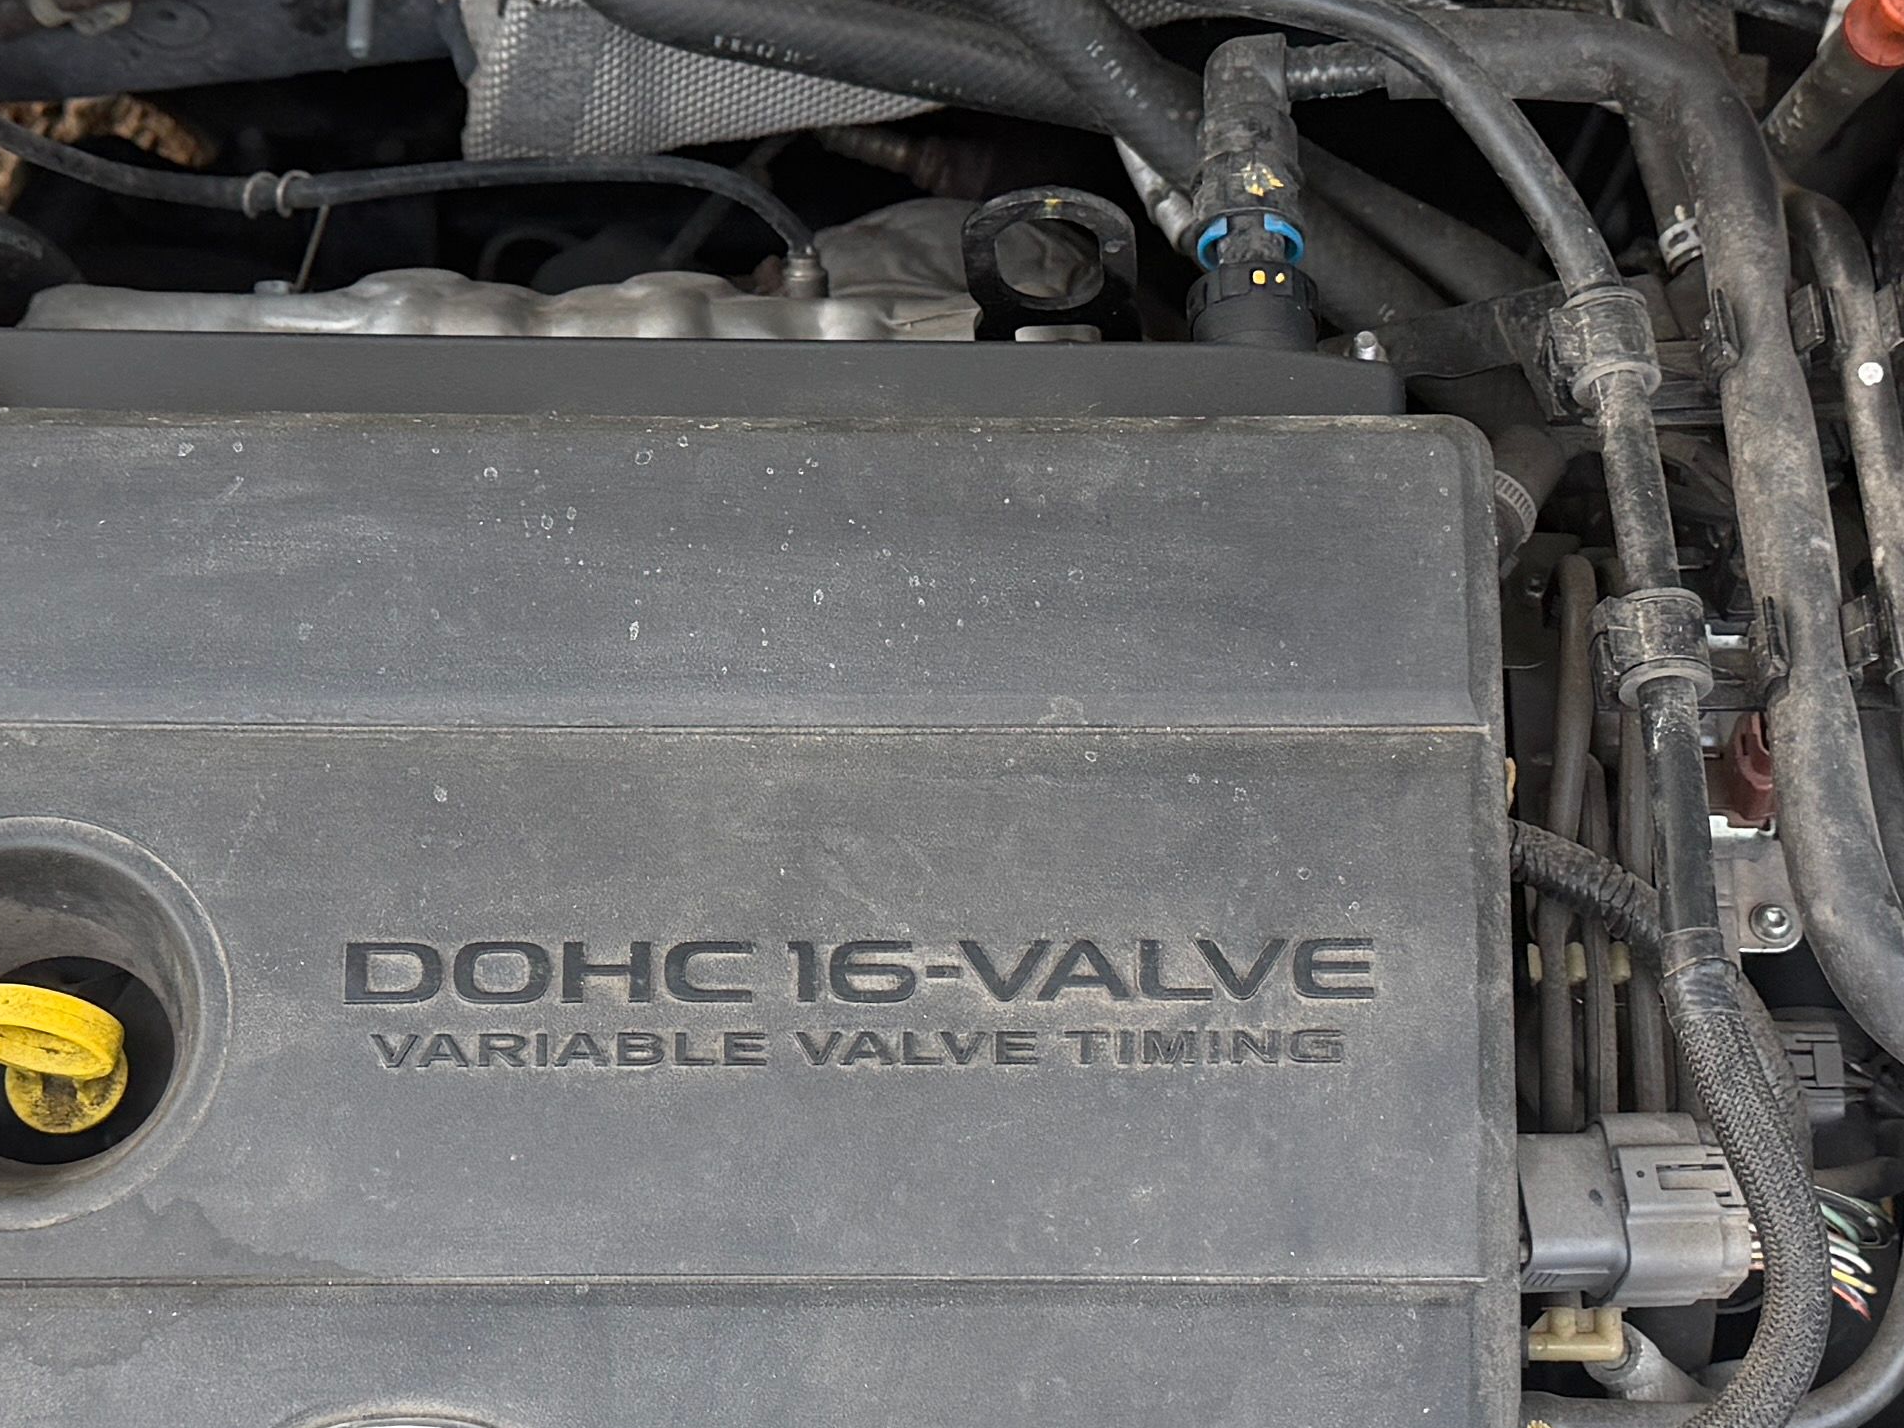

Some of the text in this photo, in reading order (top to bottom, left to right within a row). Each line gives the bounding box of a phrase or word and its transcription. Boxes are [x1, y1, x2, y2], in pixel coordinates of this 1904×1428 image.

[342, 935, 1377, 1005] DOHC 16-VALVE
[370, 1025, 1347, 1070] VARIABLE VALVE TIMING
